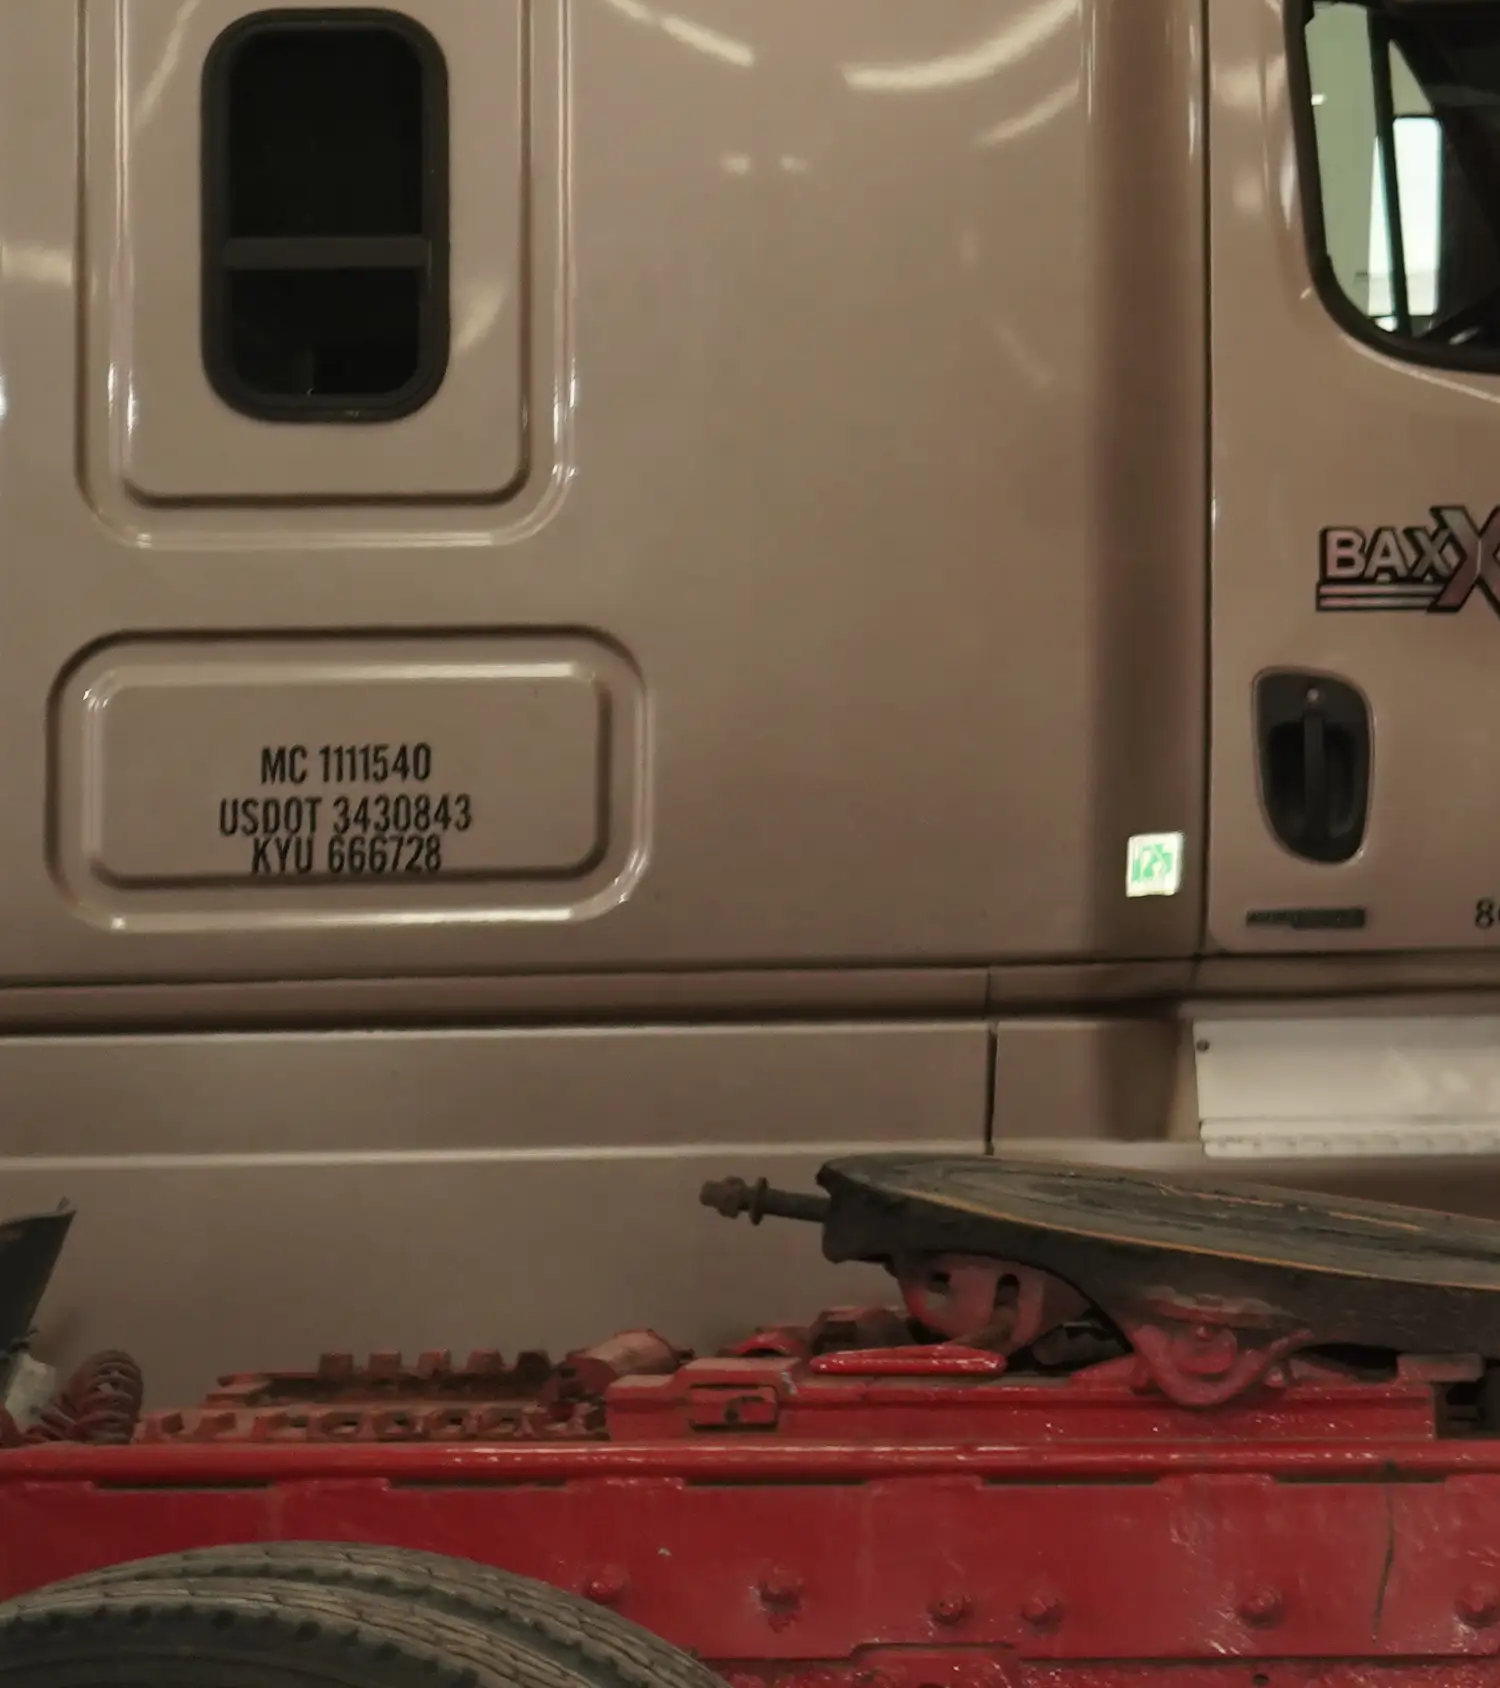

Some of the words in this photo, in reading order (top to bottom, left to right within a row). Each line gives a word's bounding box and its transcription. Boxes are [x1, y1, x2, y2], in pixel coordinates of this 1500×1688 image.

[260, 745, 308, 784] MC
[318, 742, 432, 783] 1111540
[219, 796, 322, 836] USDOT
[333, 793, 473, 834] 3430843
[251, 836, 314, 874] KYU
[327, 834, 443, 874] 666728
